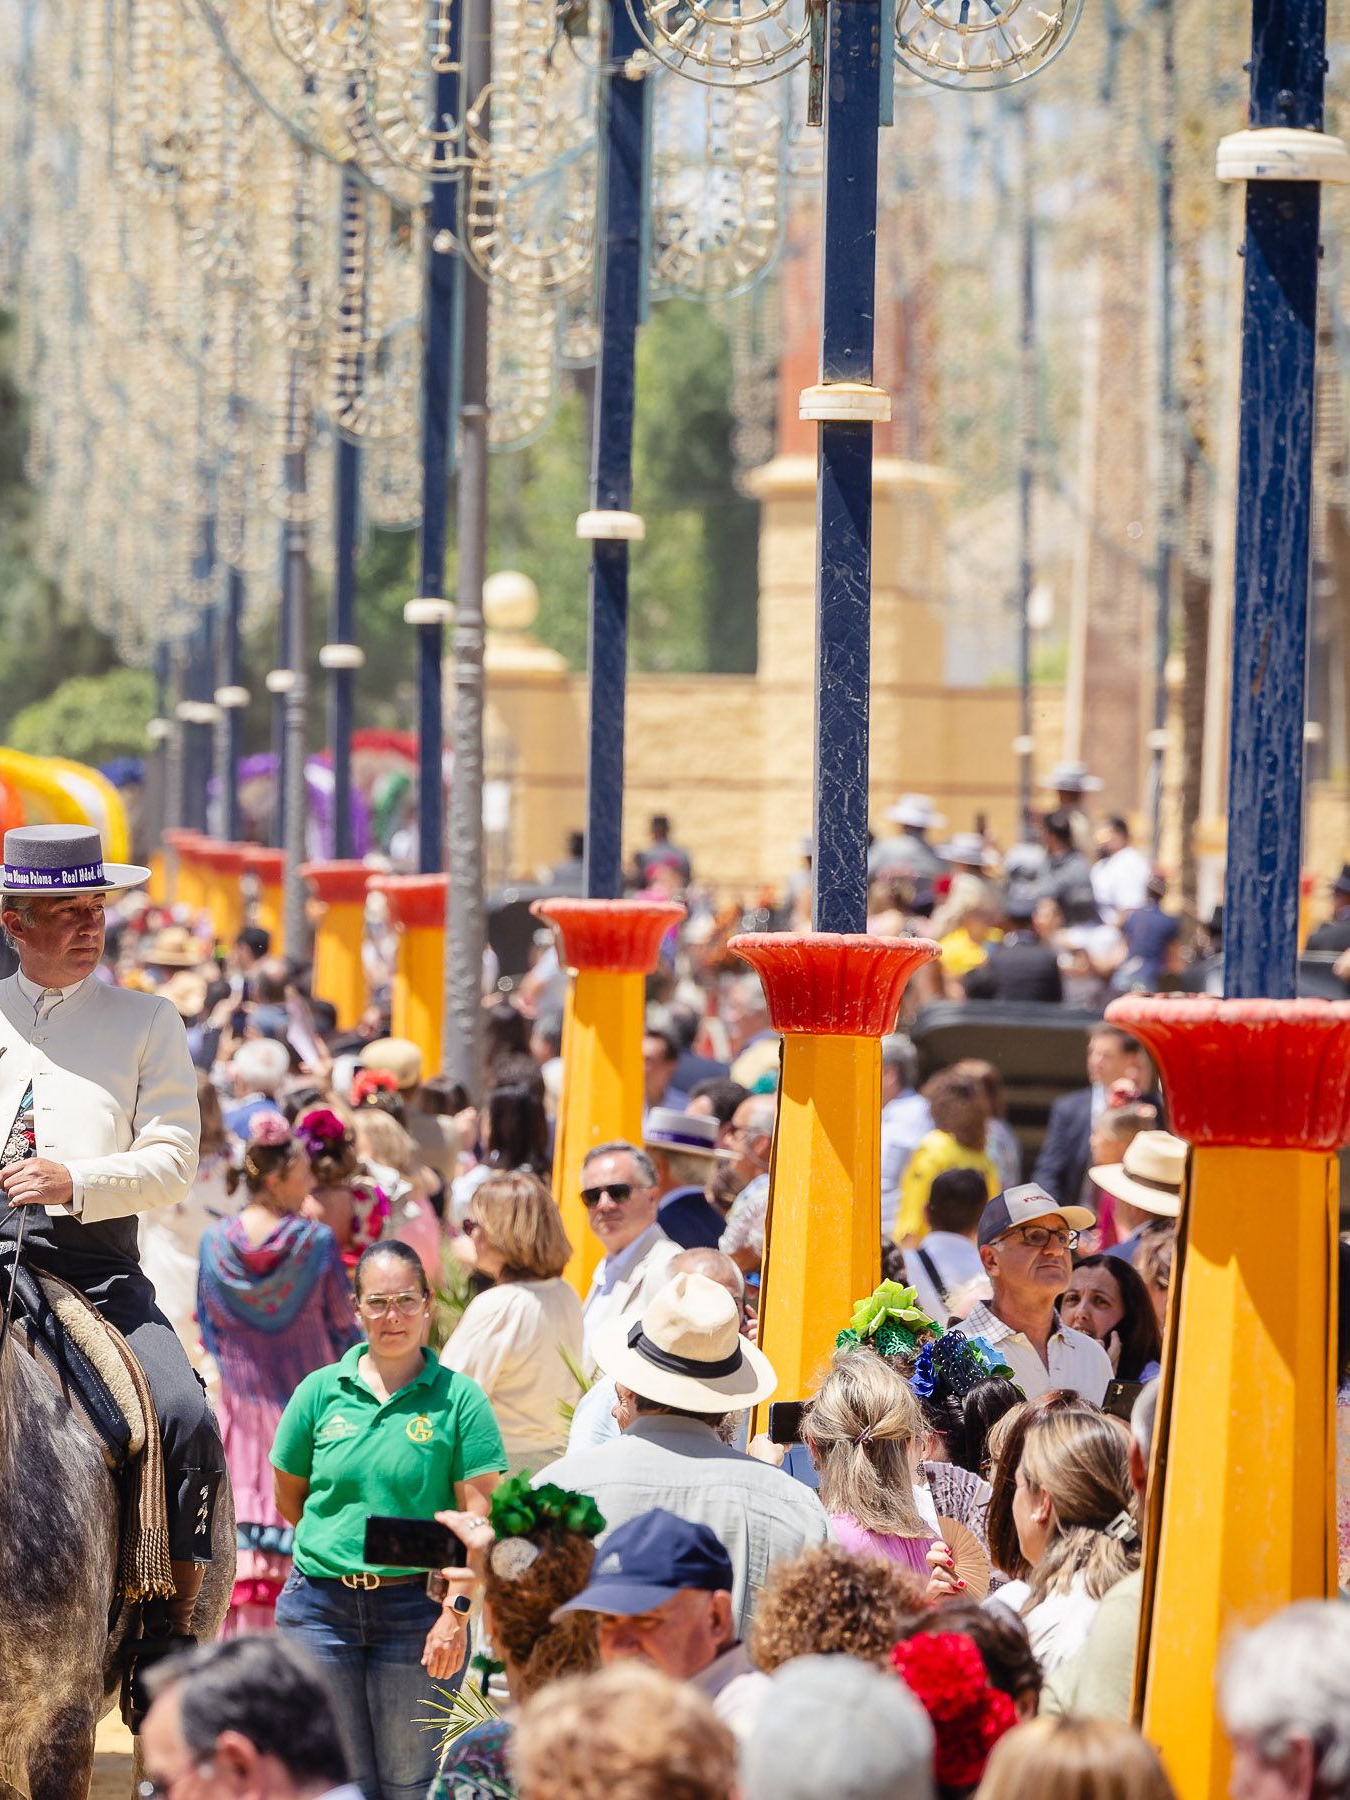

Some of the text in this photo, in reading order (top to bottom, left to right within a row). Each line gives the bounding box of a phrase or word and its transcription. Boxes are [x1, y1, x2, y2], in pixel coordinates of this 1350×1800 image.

[13, 869, 30, 885] Blanca
[30, 870, 52, 885] Paloma
[61, 869, 78, 885] Real
